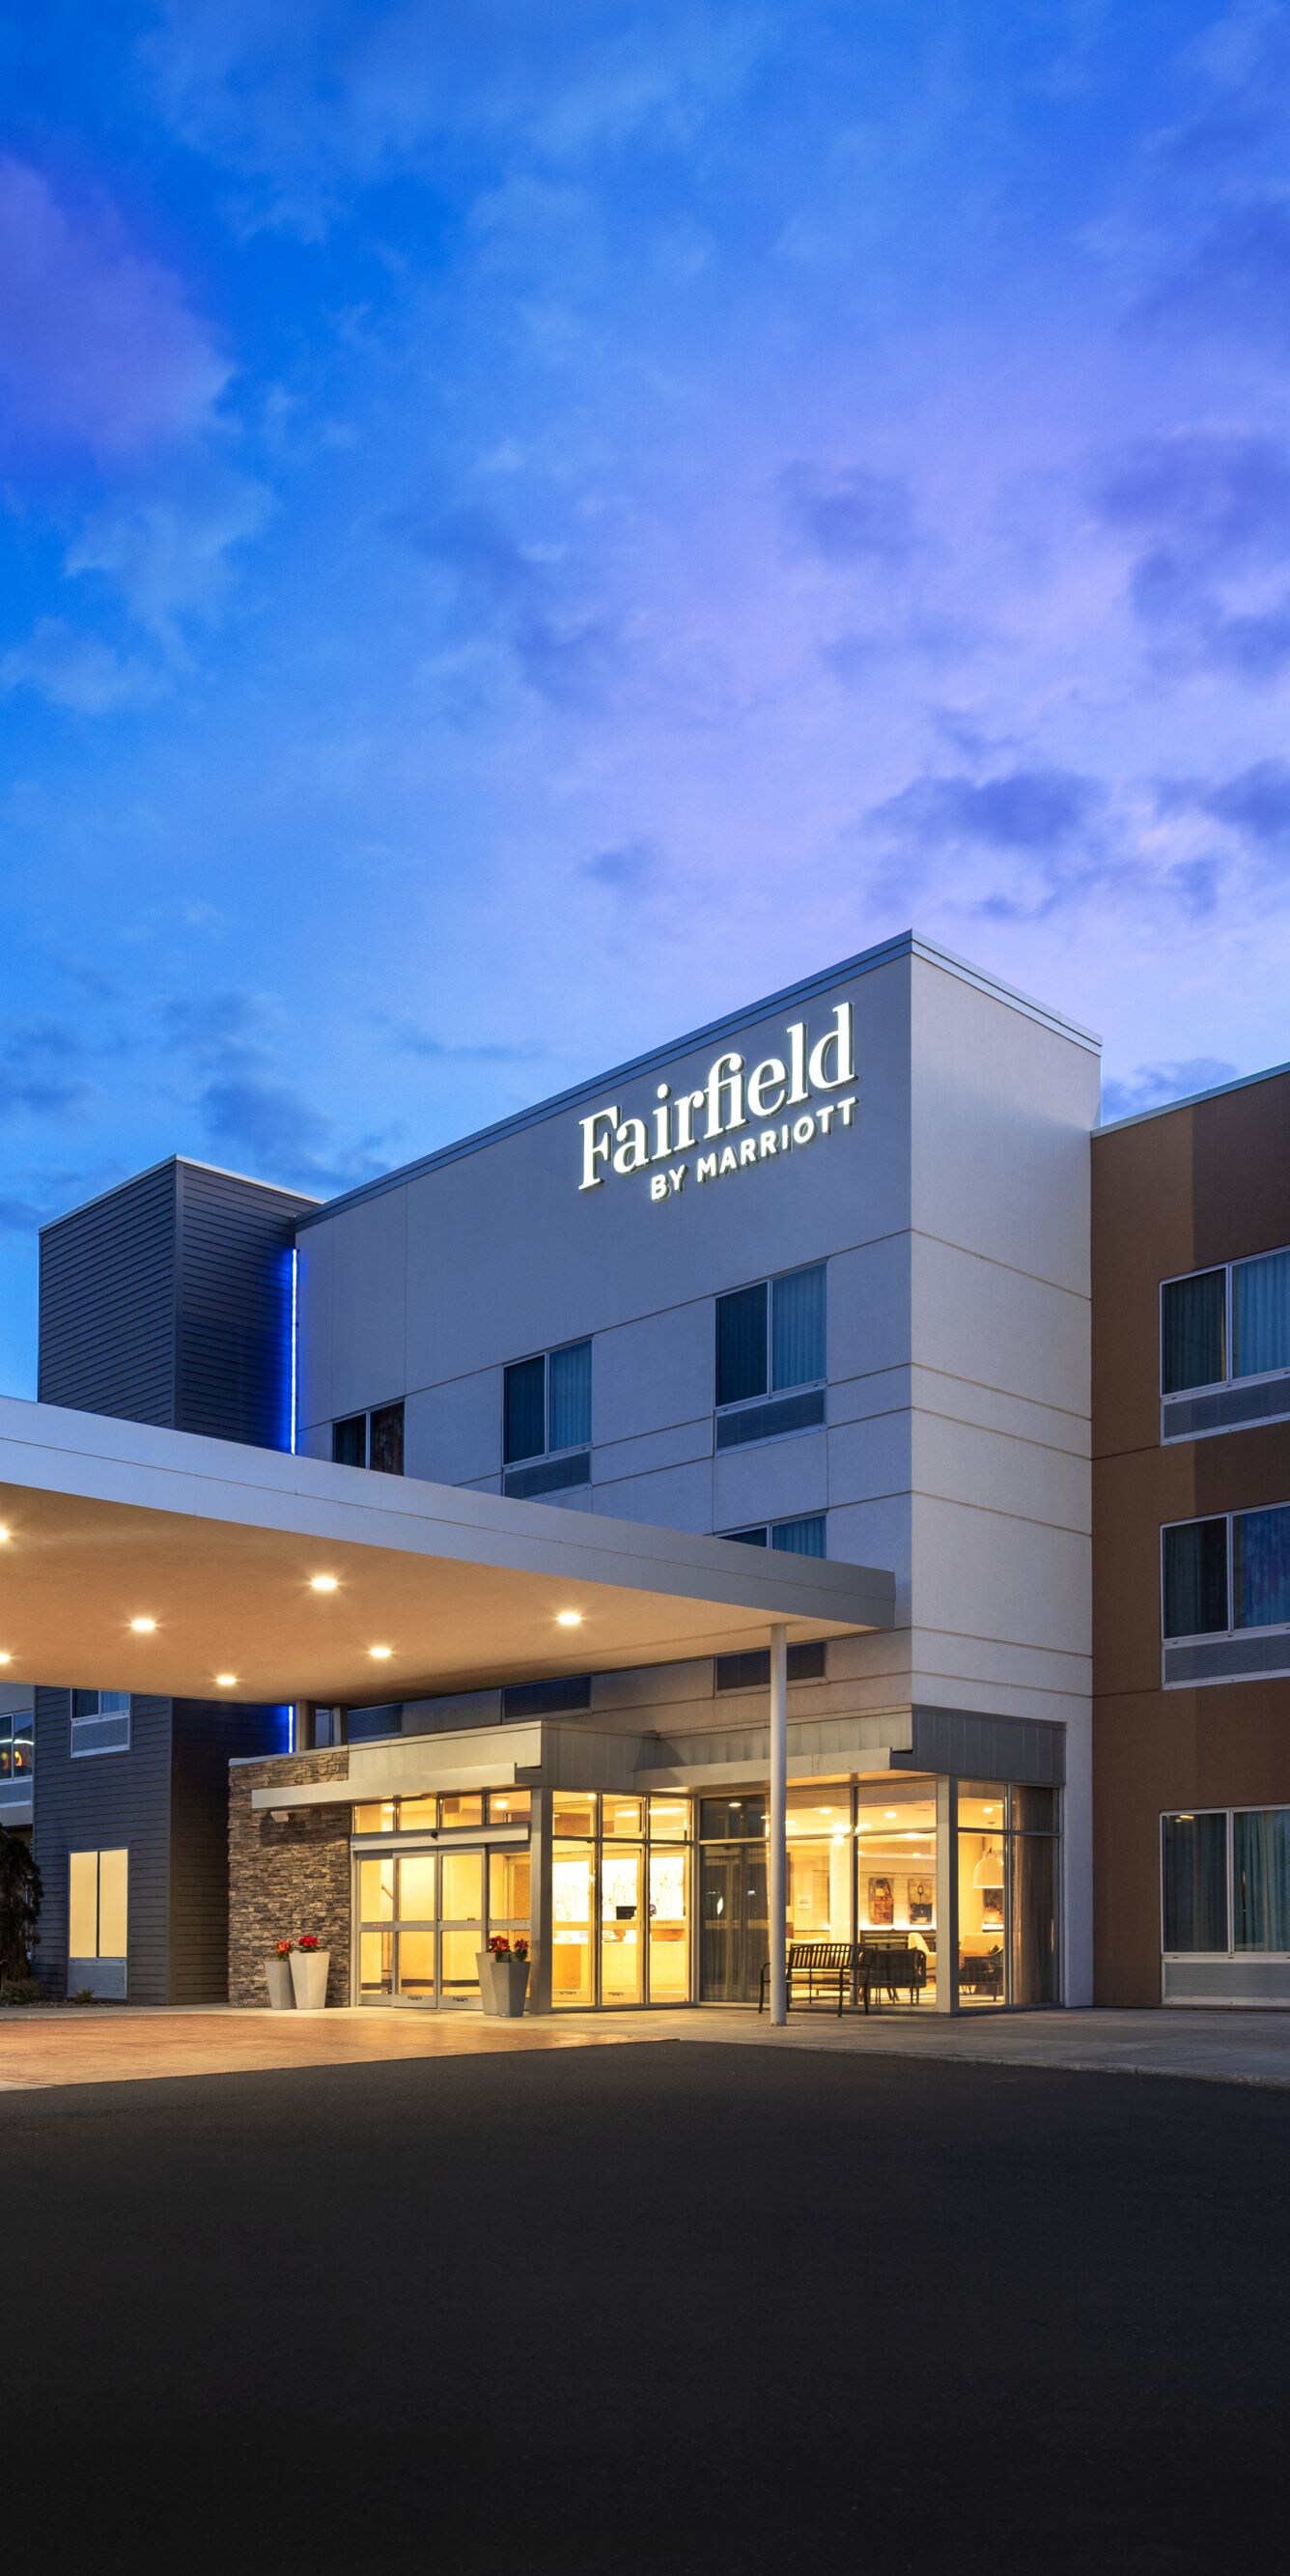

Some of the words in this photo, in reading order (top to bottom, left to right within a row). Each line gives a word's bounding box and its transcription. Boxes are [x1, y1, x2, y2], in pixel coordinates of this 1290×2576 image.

[578, 1002, 857, 1191] Fairfield
[651, 1165, 687, 1201] BY
[697, 1096, 858, 1182] MARRIOTT
